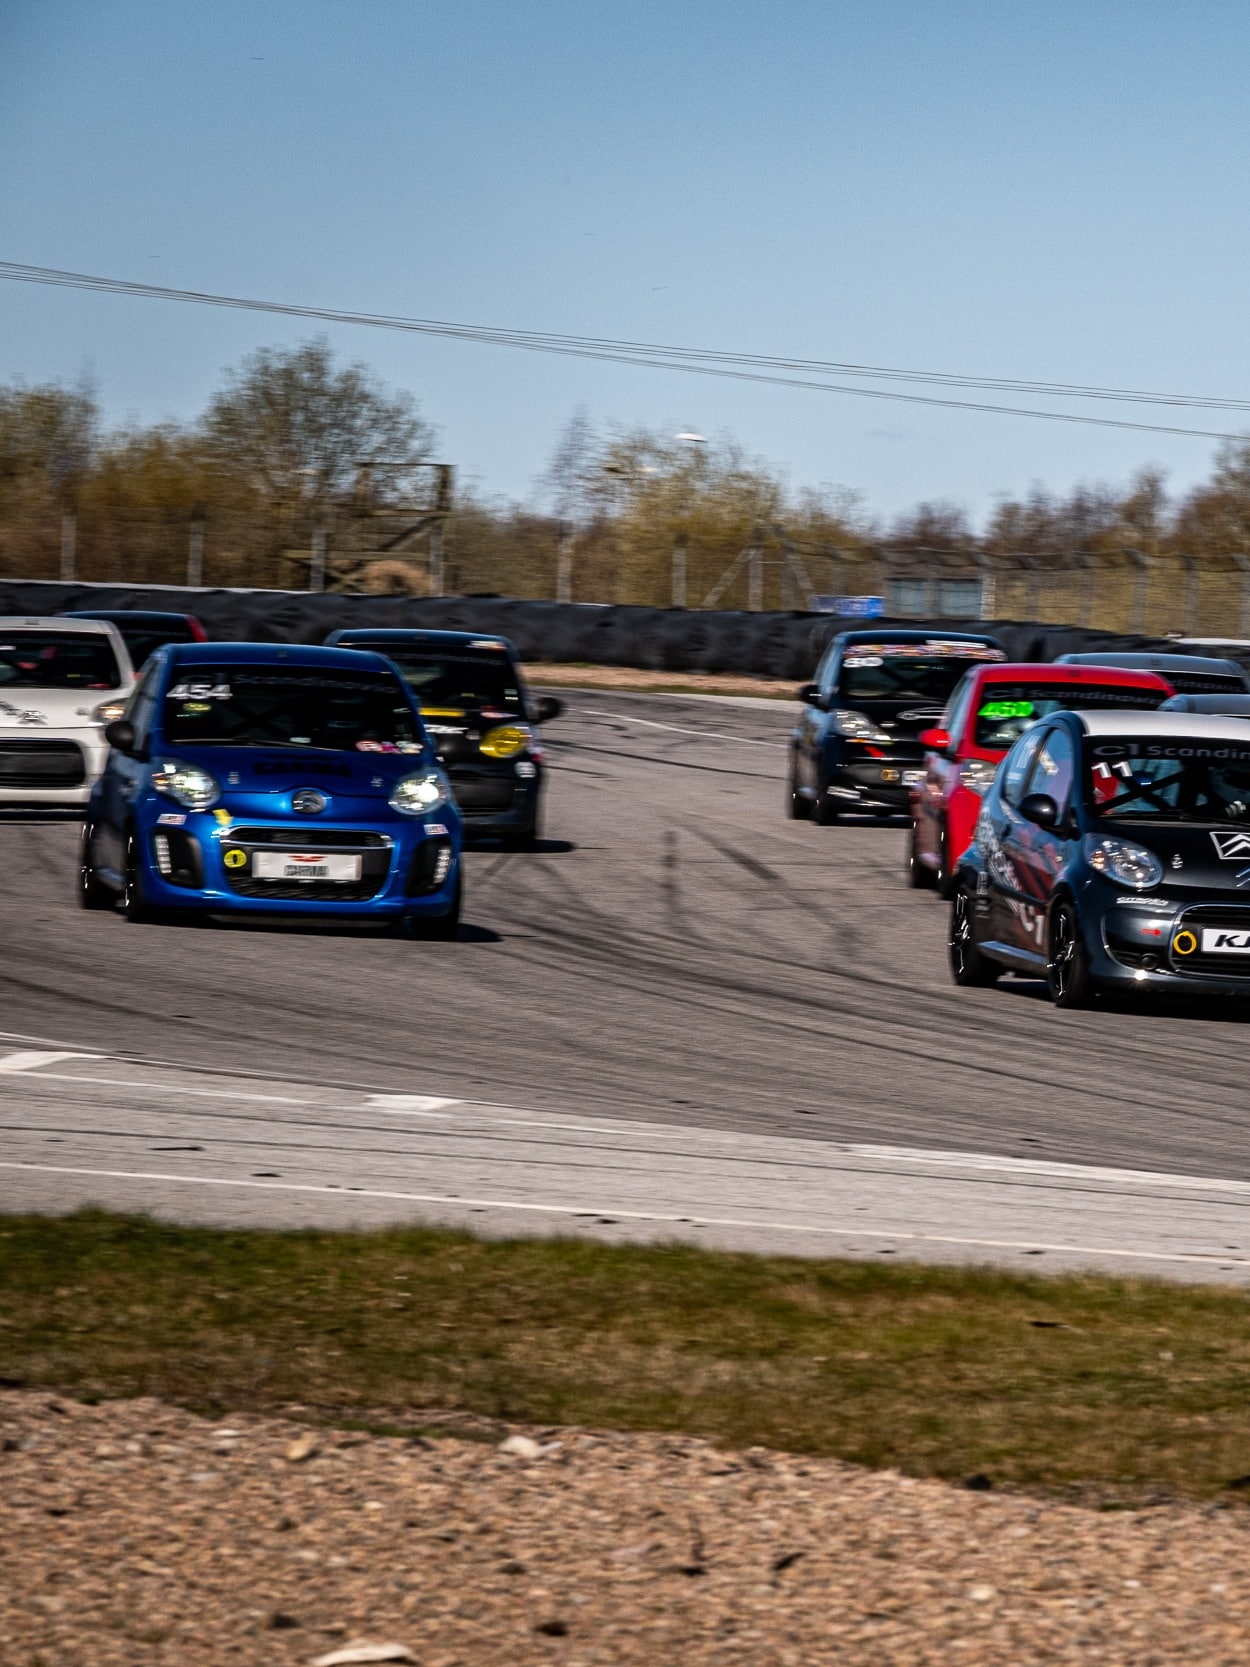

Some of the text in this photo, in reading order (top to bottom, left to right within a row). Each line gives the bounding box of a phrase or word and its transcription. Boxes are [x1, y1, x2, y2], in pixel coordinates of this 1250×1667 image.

[166, 683, 233, 700] 454
[1092, 743, 1139, 756] C1
[1091, 761, 1133, 778] 11
